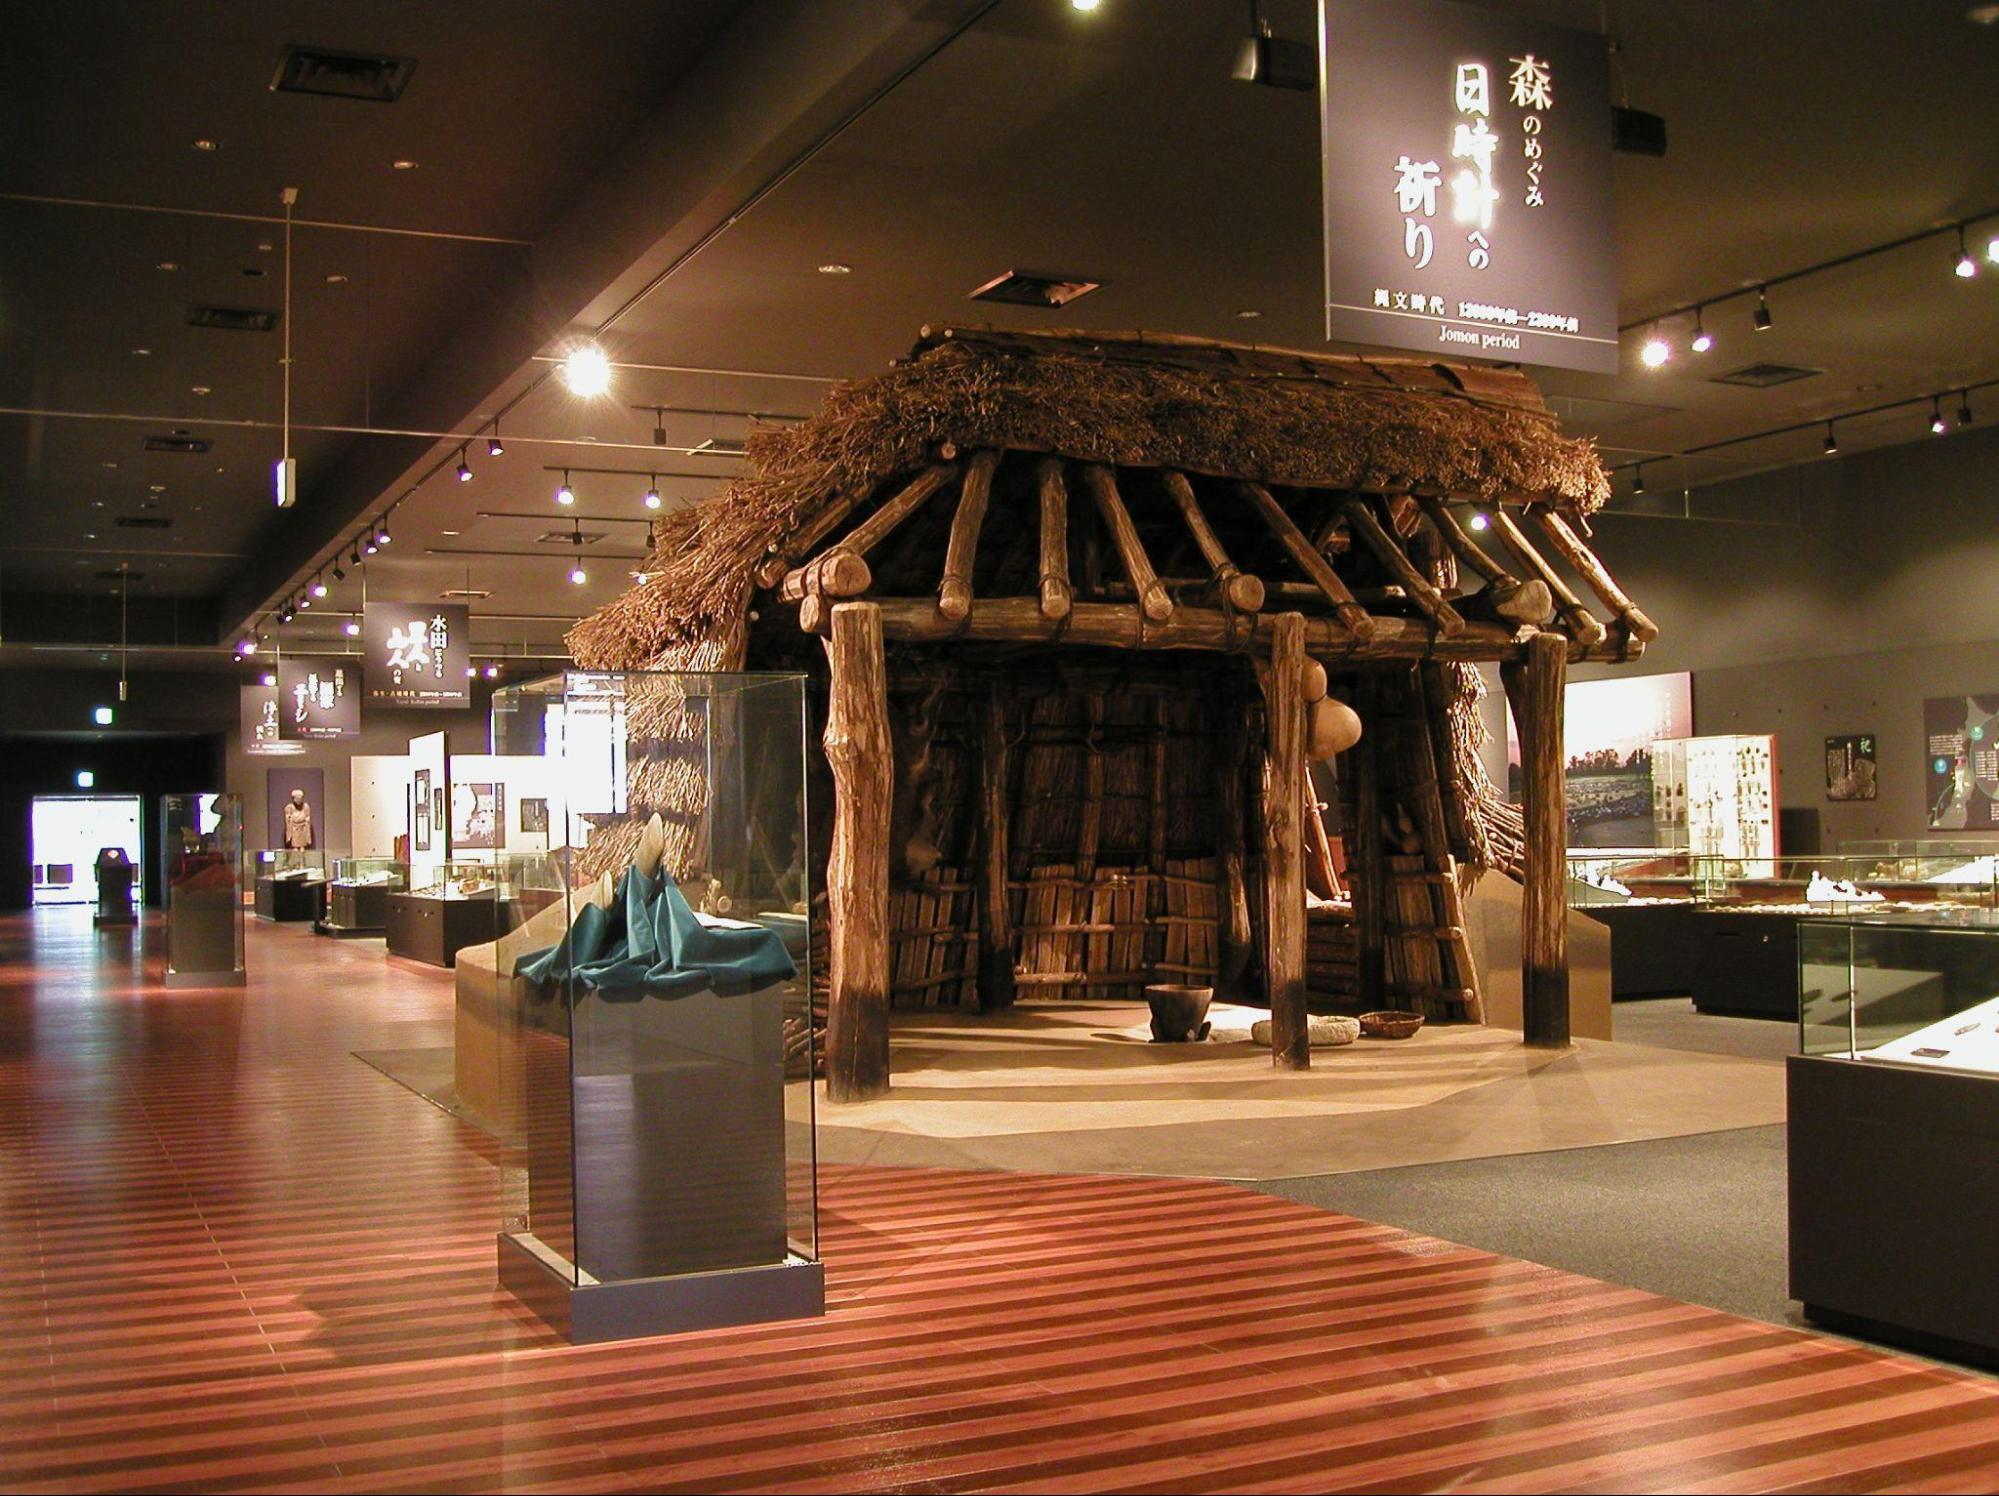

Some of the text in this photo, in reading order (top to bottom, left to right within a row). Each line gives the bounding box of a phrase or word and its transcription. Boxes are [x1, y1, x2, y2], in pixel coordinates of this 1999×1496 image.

[1508, 53, 1554, 208] 森のめぐみ
[1393, 155, 1443, 271] 祈り
[1438, 325, 1521, 350] Jomon period
